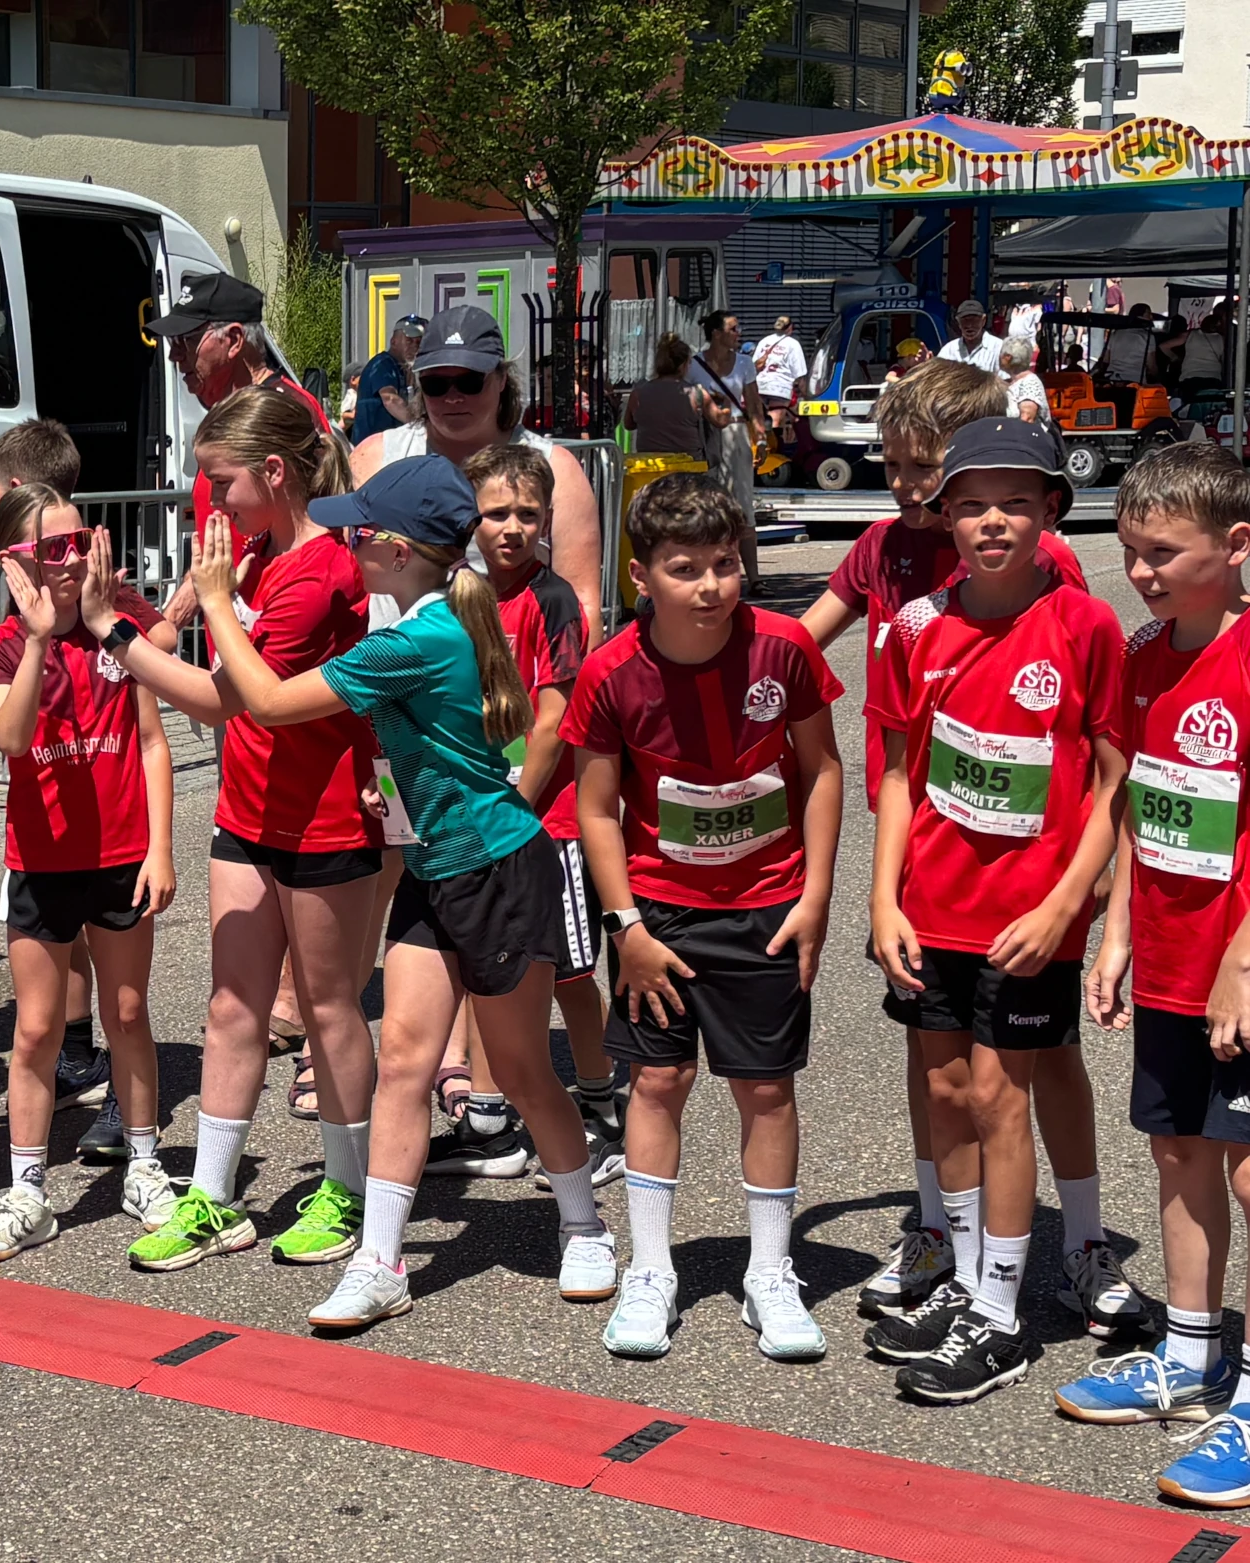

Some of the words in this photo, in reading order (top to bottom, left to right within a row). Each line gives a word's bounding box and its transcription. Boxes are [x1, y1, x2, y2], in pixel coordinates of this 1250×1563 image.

[861, 299, 925, 310] Polizei
[875, 285, 910, 297] 110
[1024, 667, 1056, 697] SG
[752, 685, 781, 708] SG
[1189, 706, 1228, 748] SG
[953, 754, 1012, 793] 595
[950, 780, 1011, 811] MORITZ
[692, 805, 756, 832] 598
[1141, 791, 1194, 829] 593
[695, 827, 755, 846] XAVER
[1140, 821, 1190, 848] MALTE
[1008, 1013, 1050, 1027] Kempa
